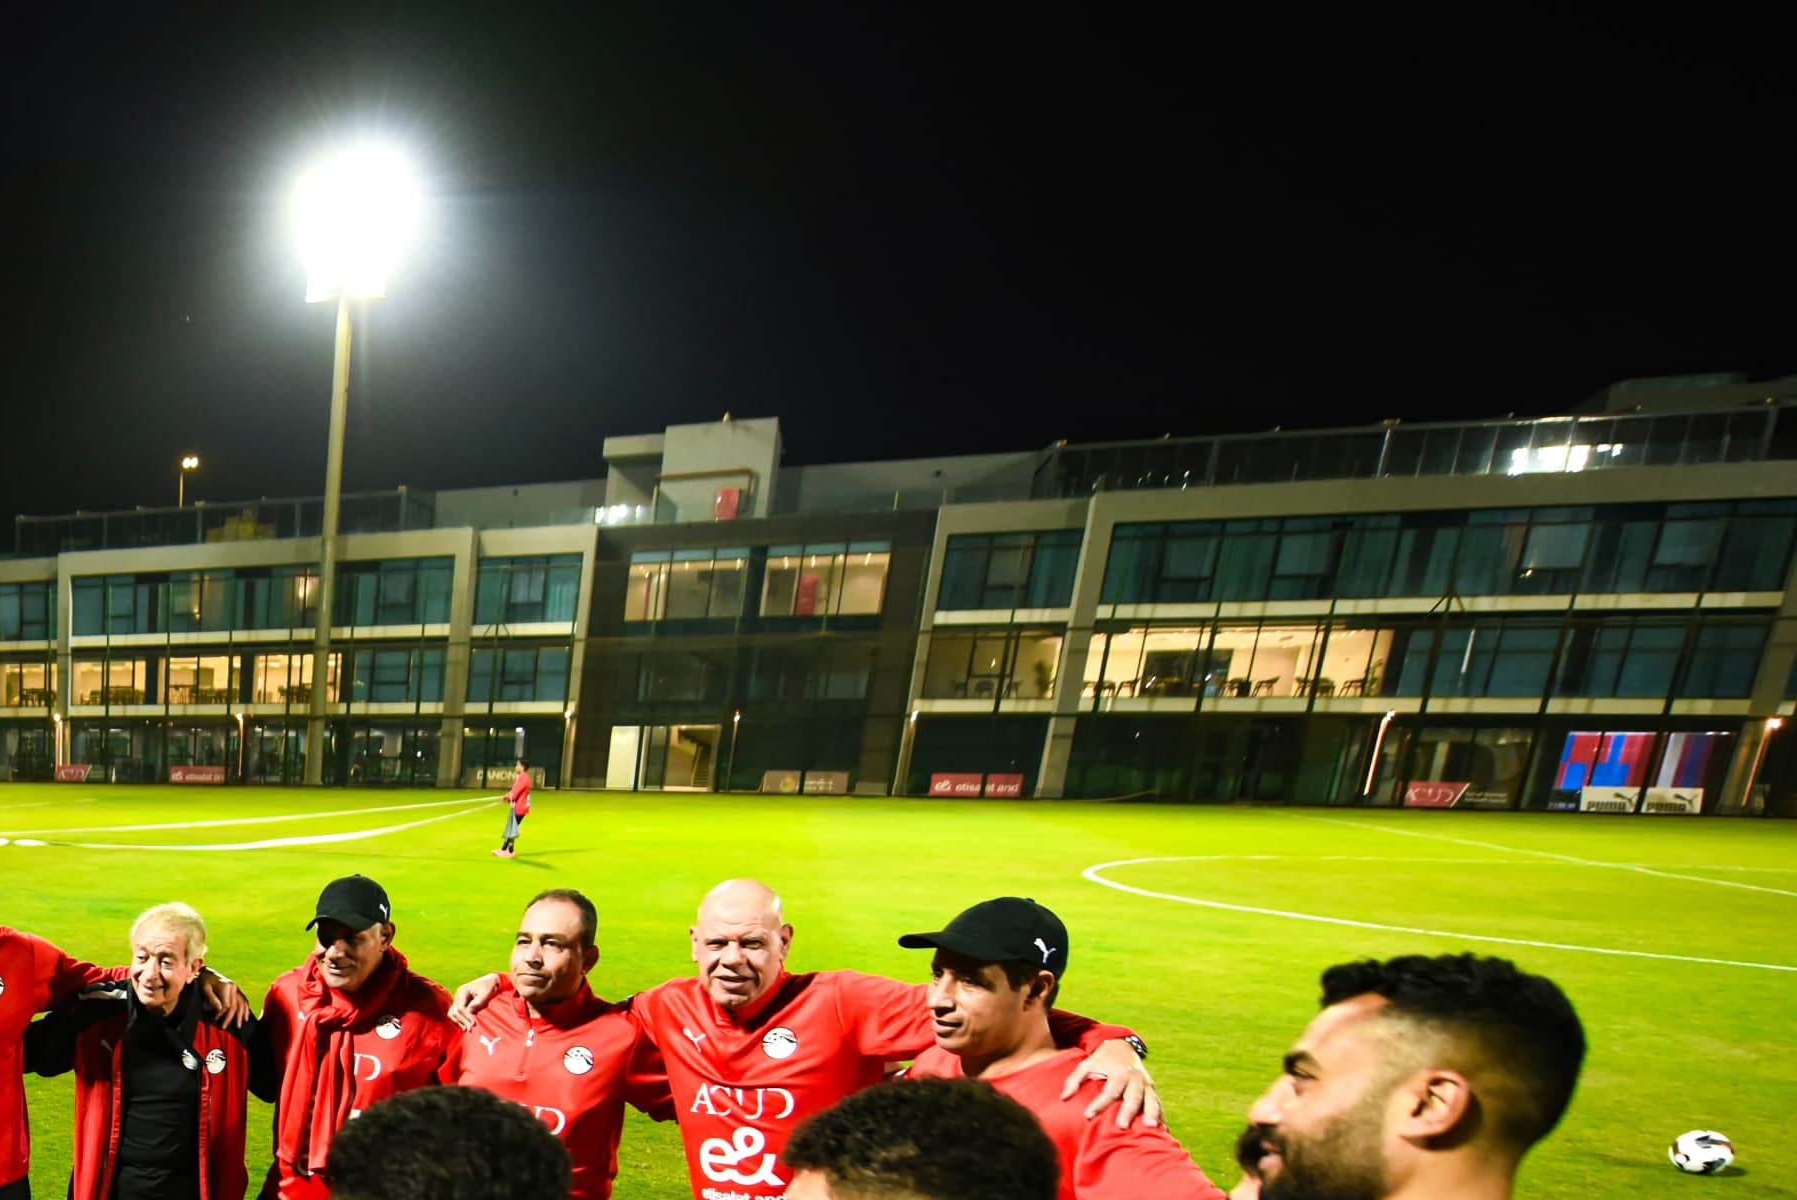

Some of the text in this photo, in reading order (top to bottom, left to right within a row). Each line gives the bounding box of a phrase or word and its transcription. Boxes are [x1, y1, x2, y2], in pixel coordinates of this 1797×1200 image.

[1587, 801, 1627, 811] PUMA
[1646, 803, 1687, 813] PUMA
[690, 1083, 795, 1120] ACUD
